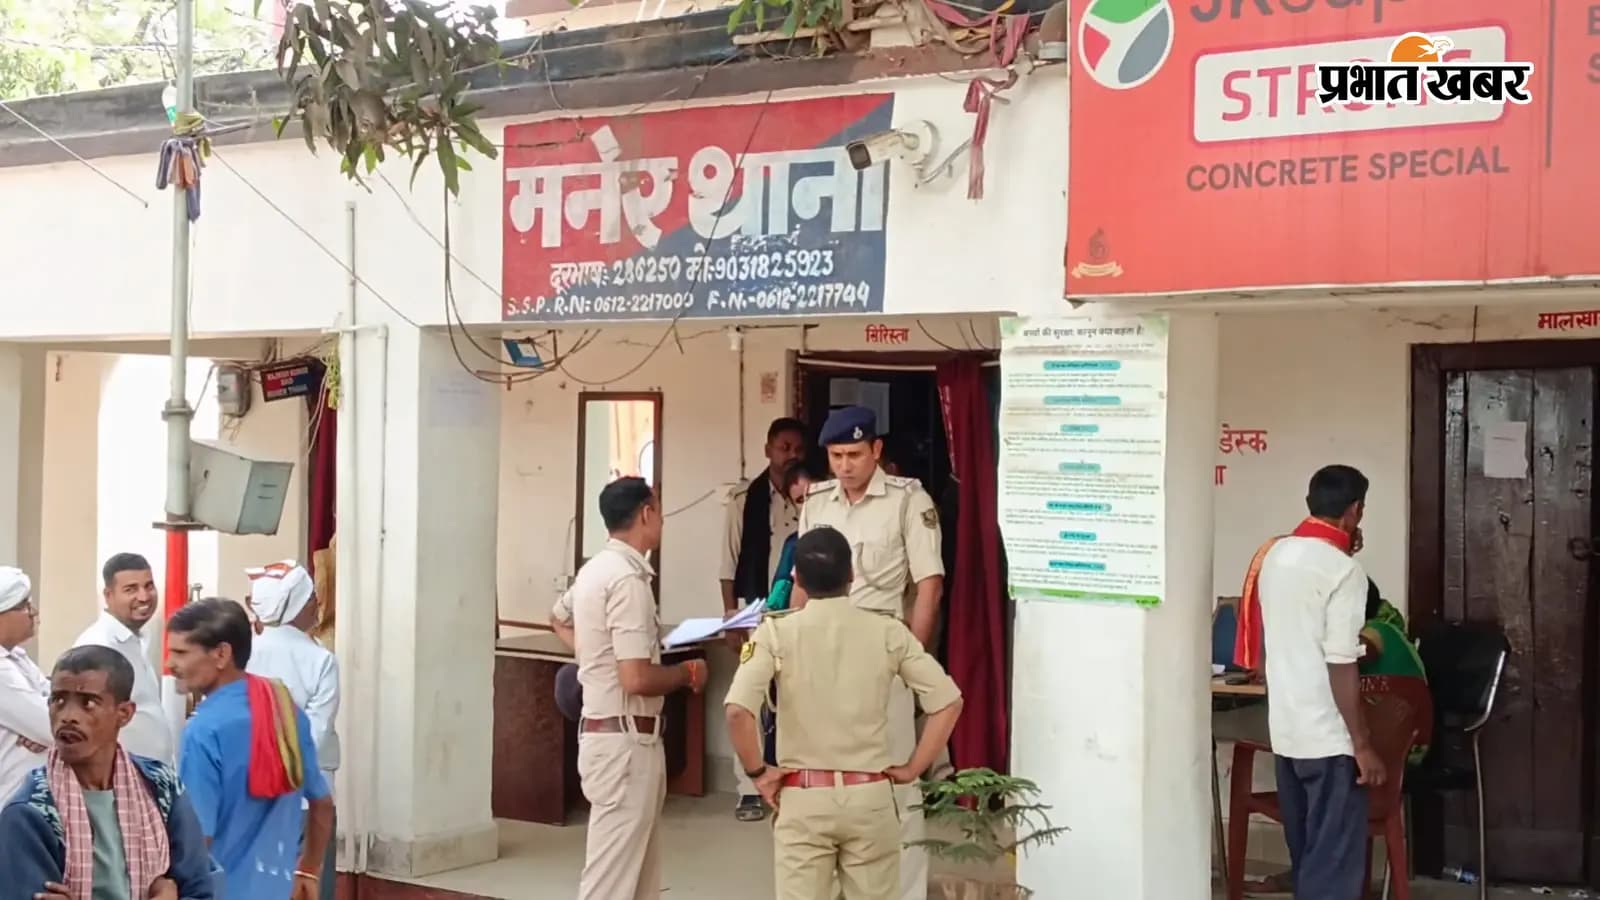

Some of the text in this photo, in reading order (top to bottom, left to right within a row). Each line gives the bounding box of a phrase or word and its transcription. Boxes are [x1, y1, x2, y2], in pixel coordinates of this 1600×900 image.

[1186, 145, 1510, 191] CONCRETE SPECIAL
[505, 125, 884, 250] मनेर थाना
[611, 255, 681, 286] 286250
[1538, 310, 1600, 331] मालखा
[1219, 423, 1268, 456] डेस्क
